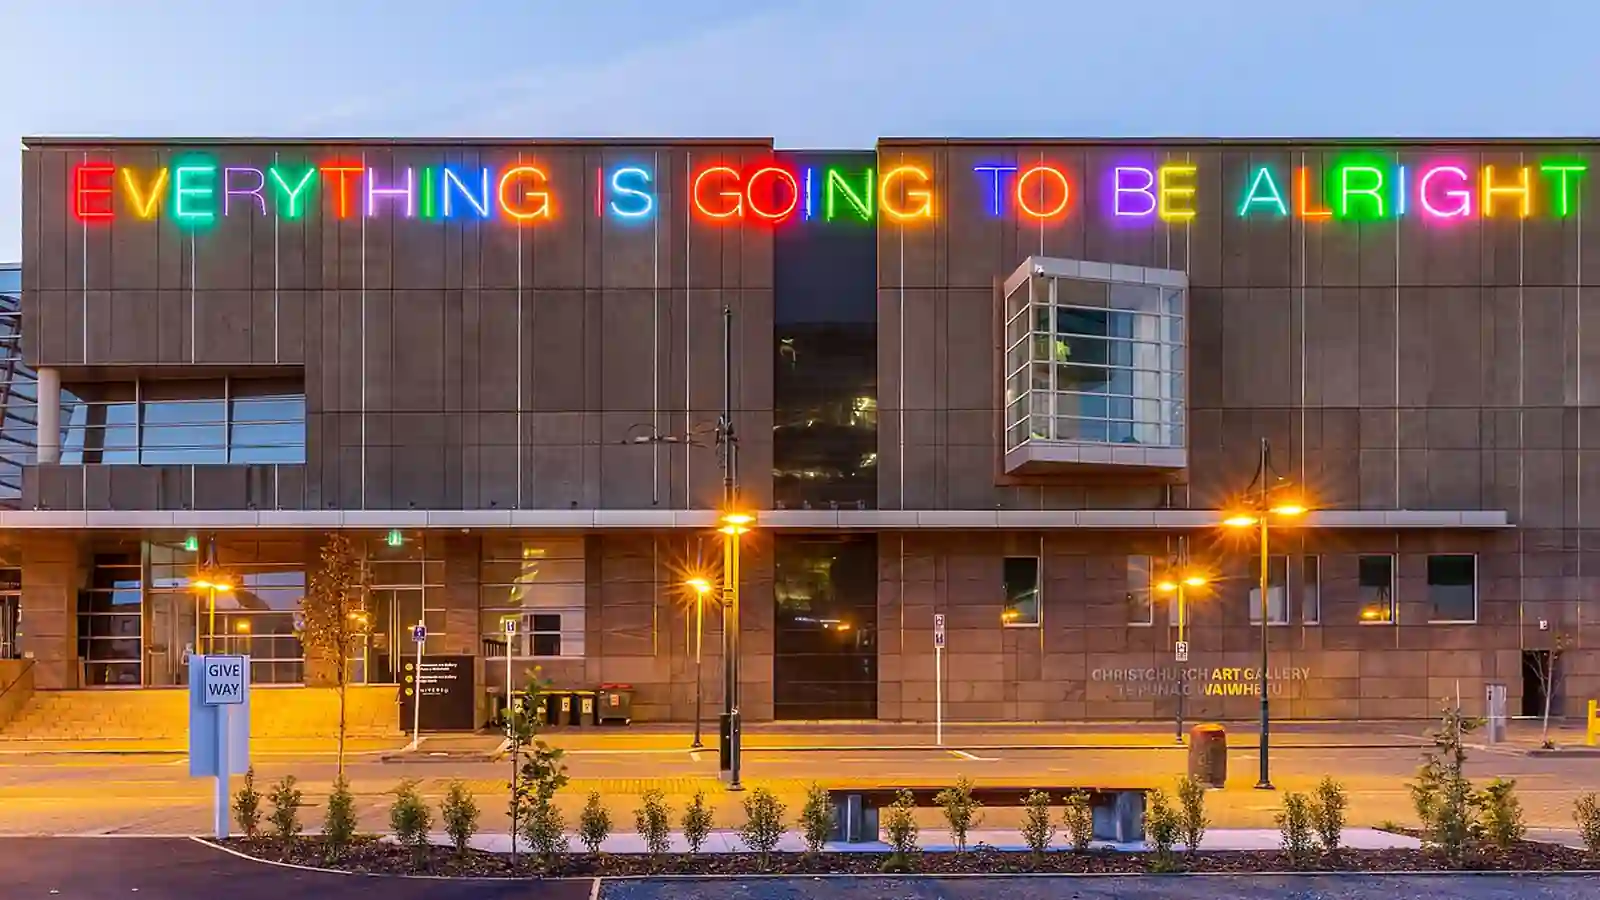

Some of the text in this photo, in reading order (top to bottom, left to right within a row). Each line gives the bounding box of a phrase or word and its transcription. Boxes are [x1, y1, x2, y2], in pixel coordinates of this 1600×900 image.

[77, 164, 1588, 221] EVERYTHING IS GOING TO BE ALRIGHT
[208, 664, 240, 677] GIVE
[1091, 668, 1209, 681] CHRISTCHURCH
[1211, 668, 1242, 681] ART
[208, 683, 240, 696] WAY
